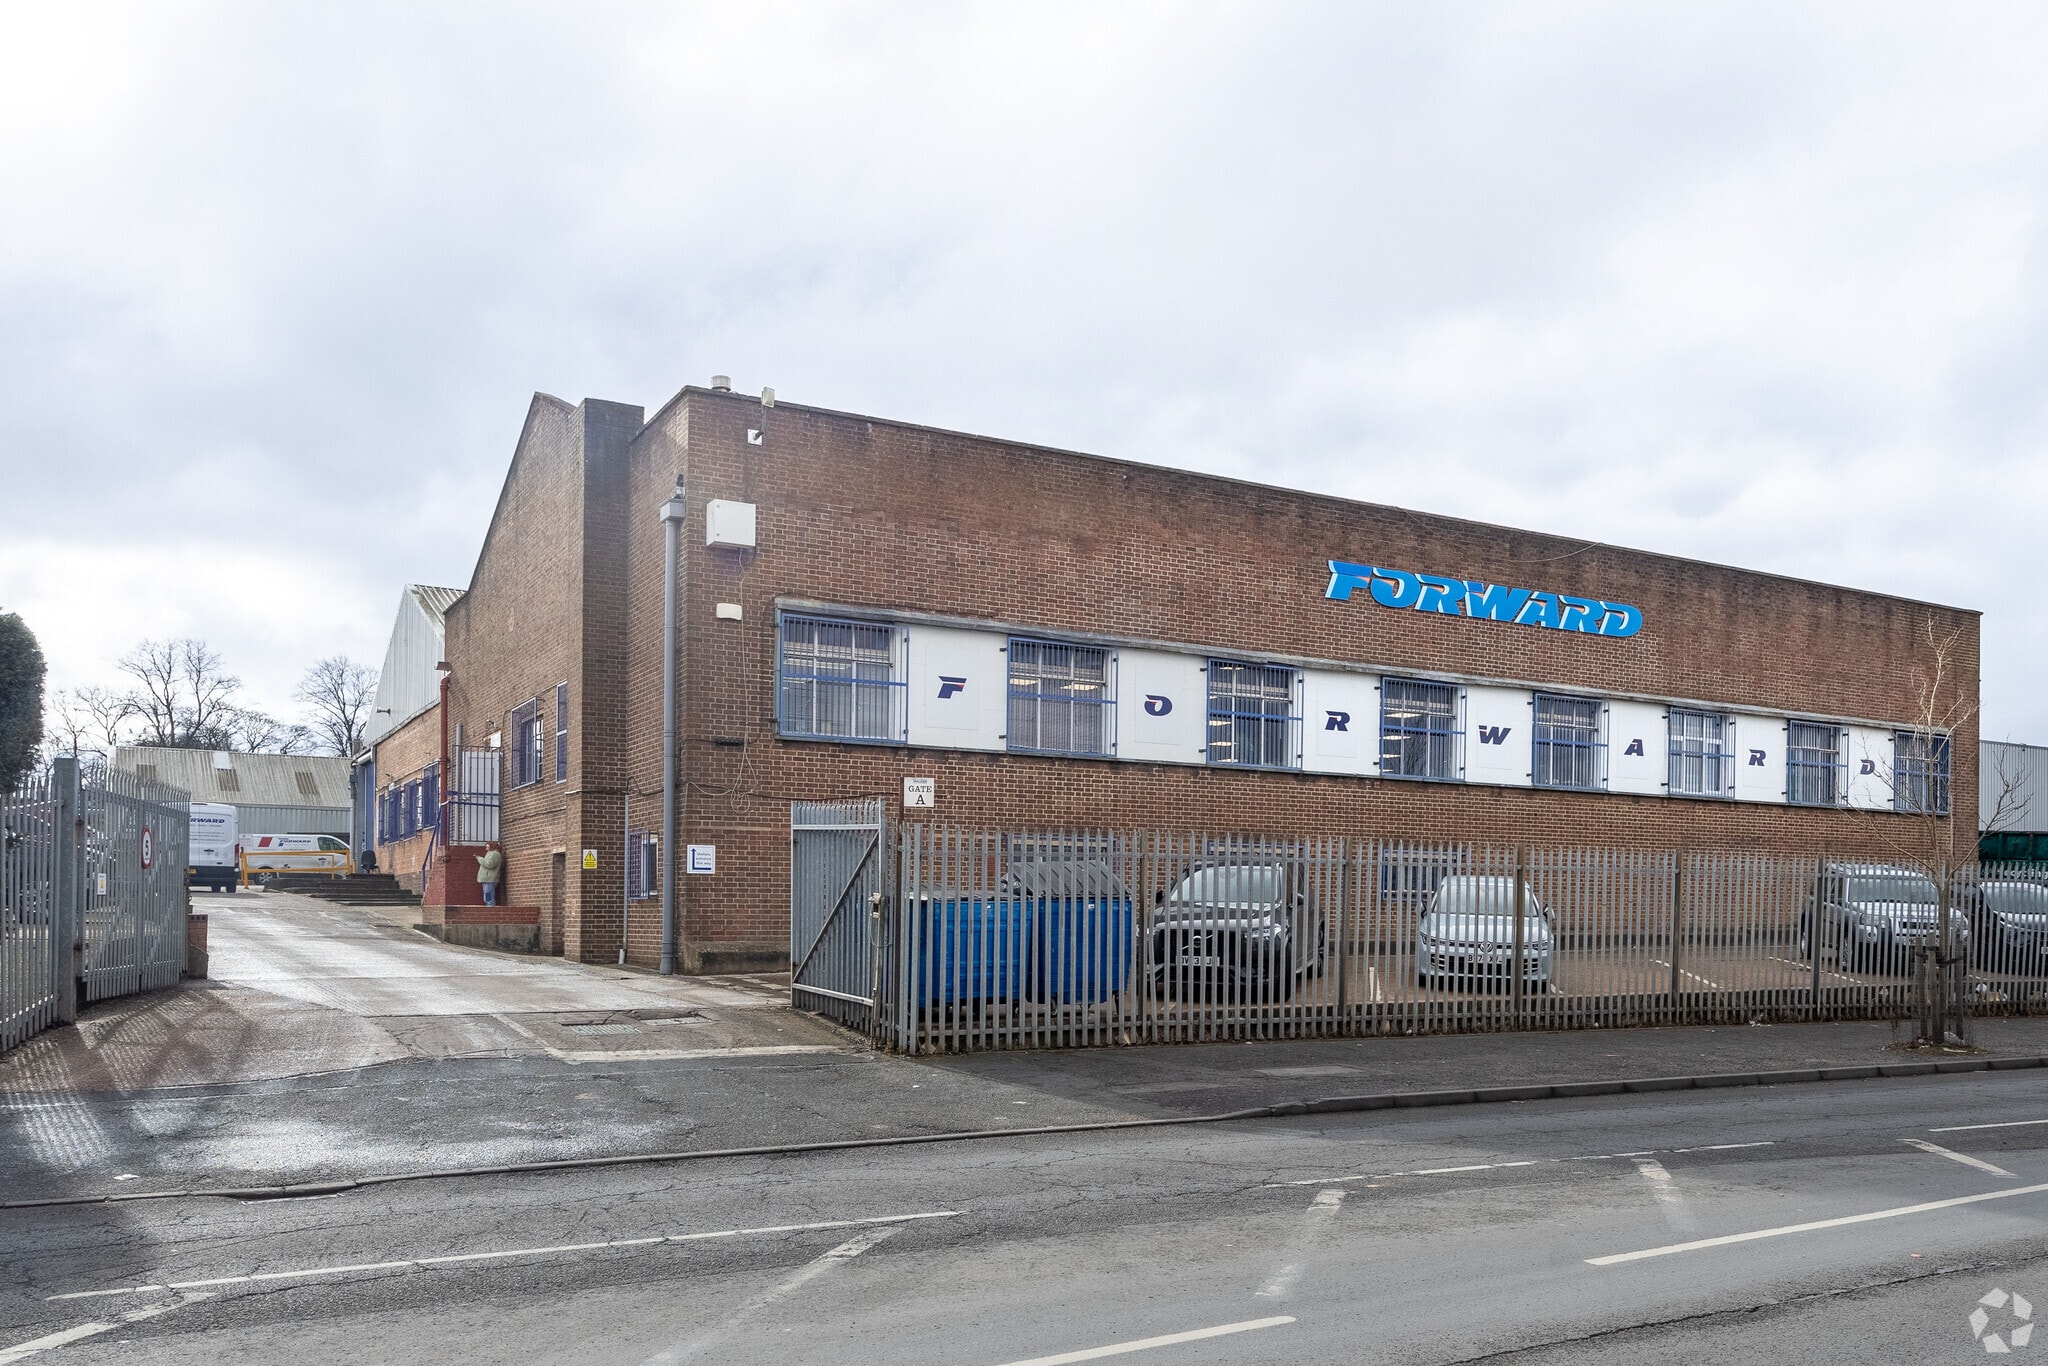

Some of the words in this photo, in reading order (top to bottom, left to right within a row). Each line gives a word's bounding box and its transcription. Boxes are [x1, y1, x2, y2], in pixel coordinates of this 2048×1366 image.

[1324, 559, 1644, 638] FORWARD
[937, 675, 967, 699] F
[1325, 710, 1350, 732] R
[1478, 724, 1512, 746] W
[1624, 738, 1644, 757] A
[1748, 748, 1767, 767] R
[1860, 758, 1876, 776] D
[908, 785, 933, 793] GATE
[915, 794, 927, 805] A
